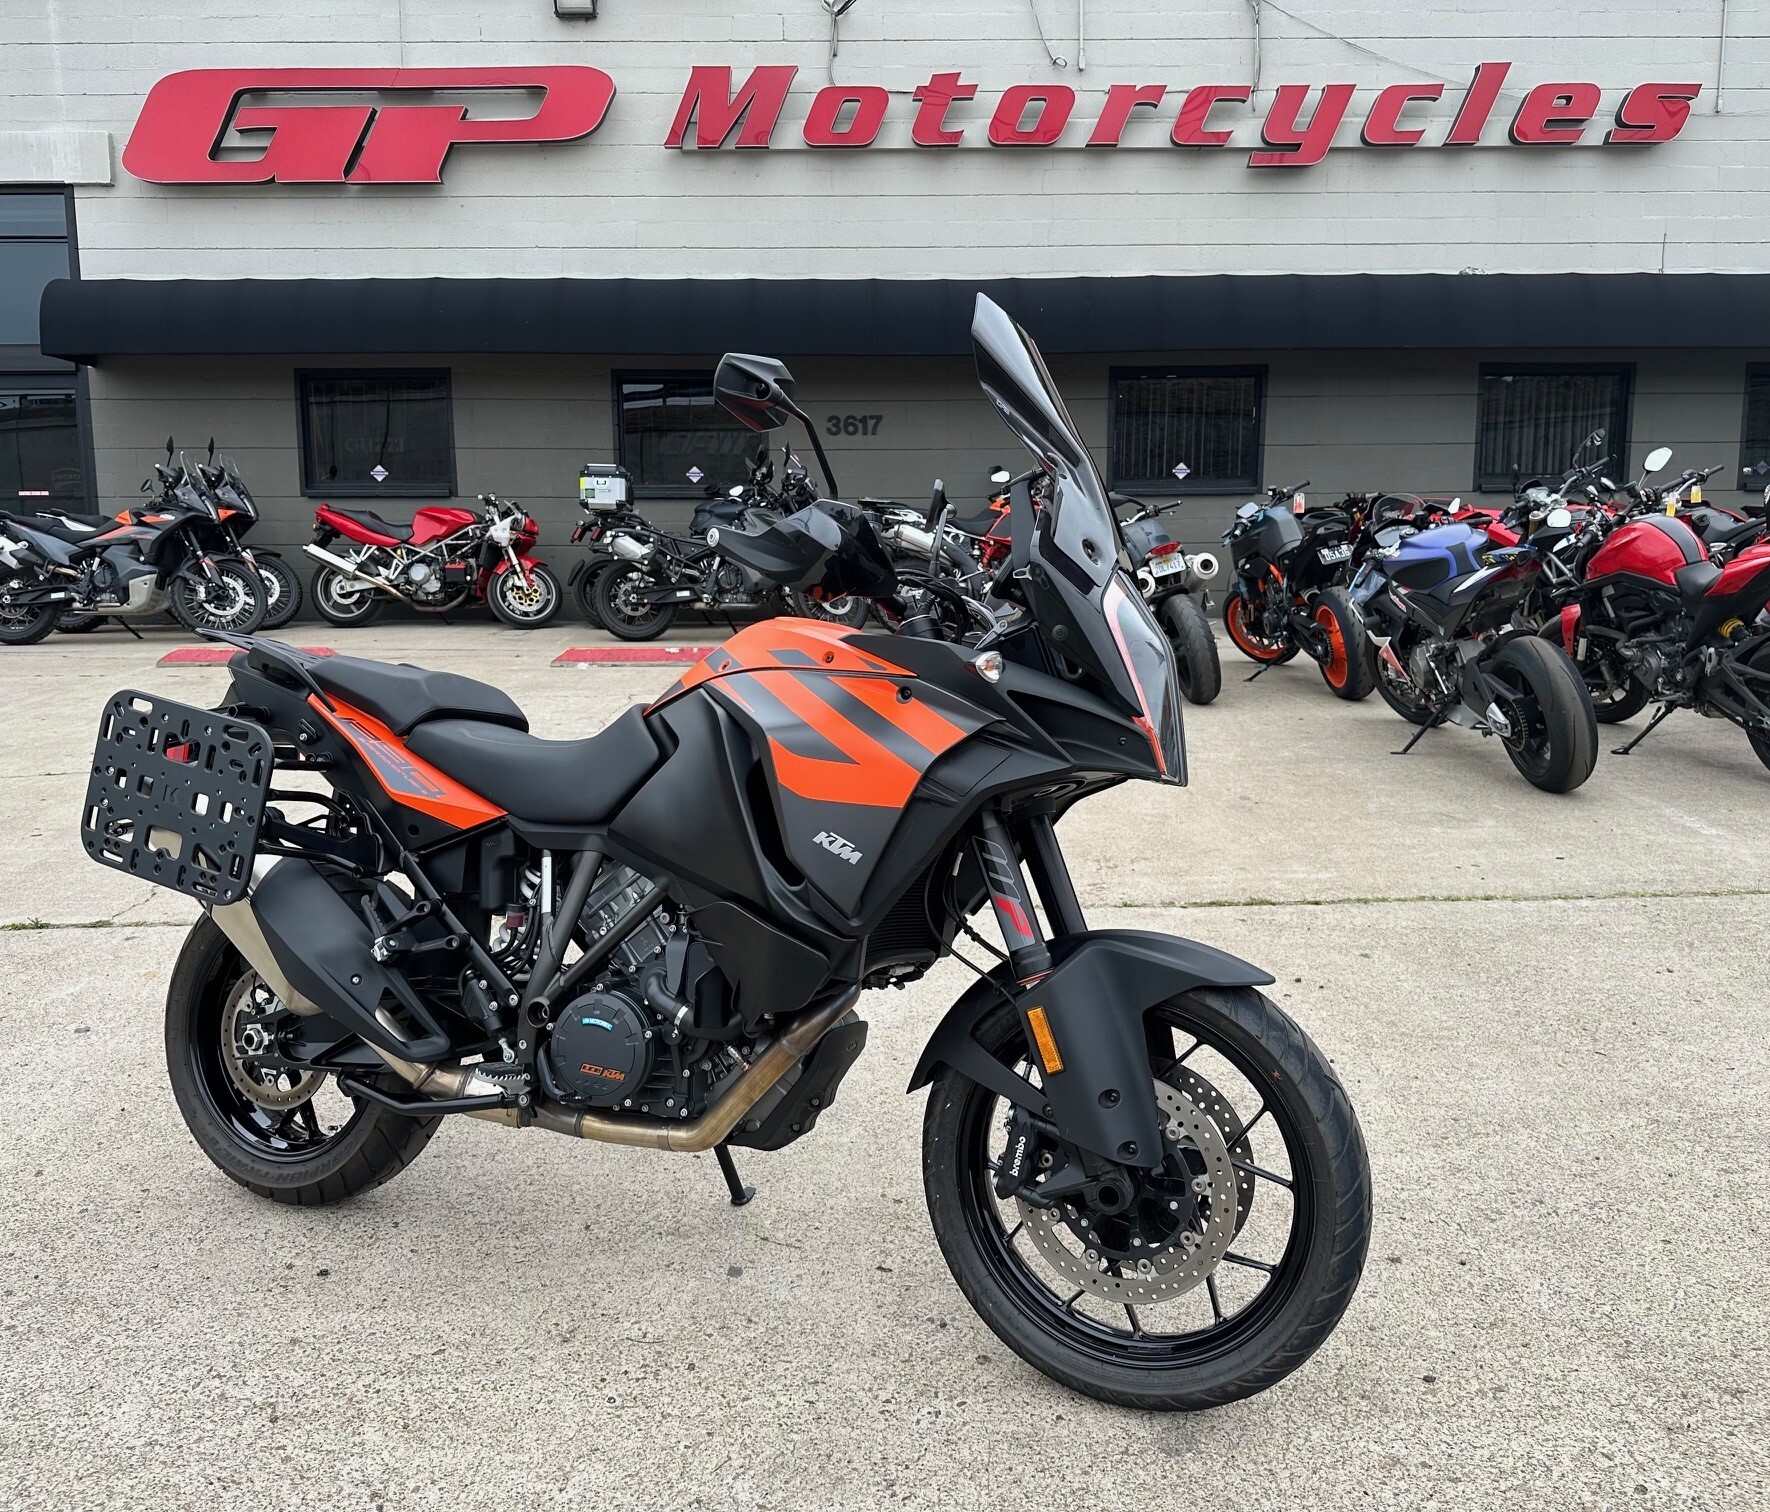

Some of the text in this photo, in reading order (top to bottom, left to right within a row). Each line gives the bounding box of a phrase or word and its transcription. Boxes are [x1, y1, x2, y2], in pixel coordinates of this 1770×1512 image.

[122, 62, 1702, 185] GP Motorcycles
[826, 414, 883, 436] 3617
[812, 831, 863, 865] KTM
[1009, 1136, 1026, 1177] brembo
